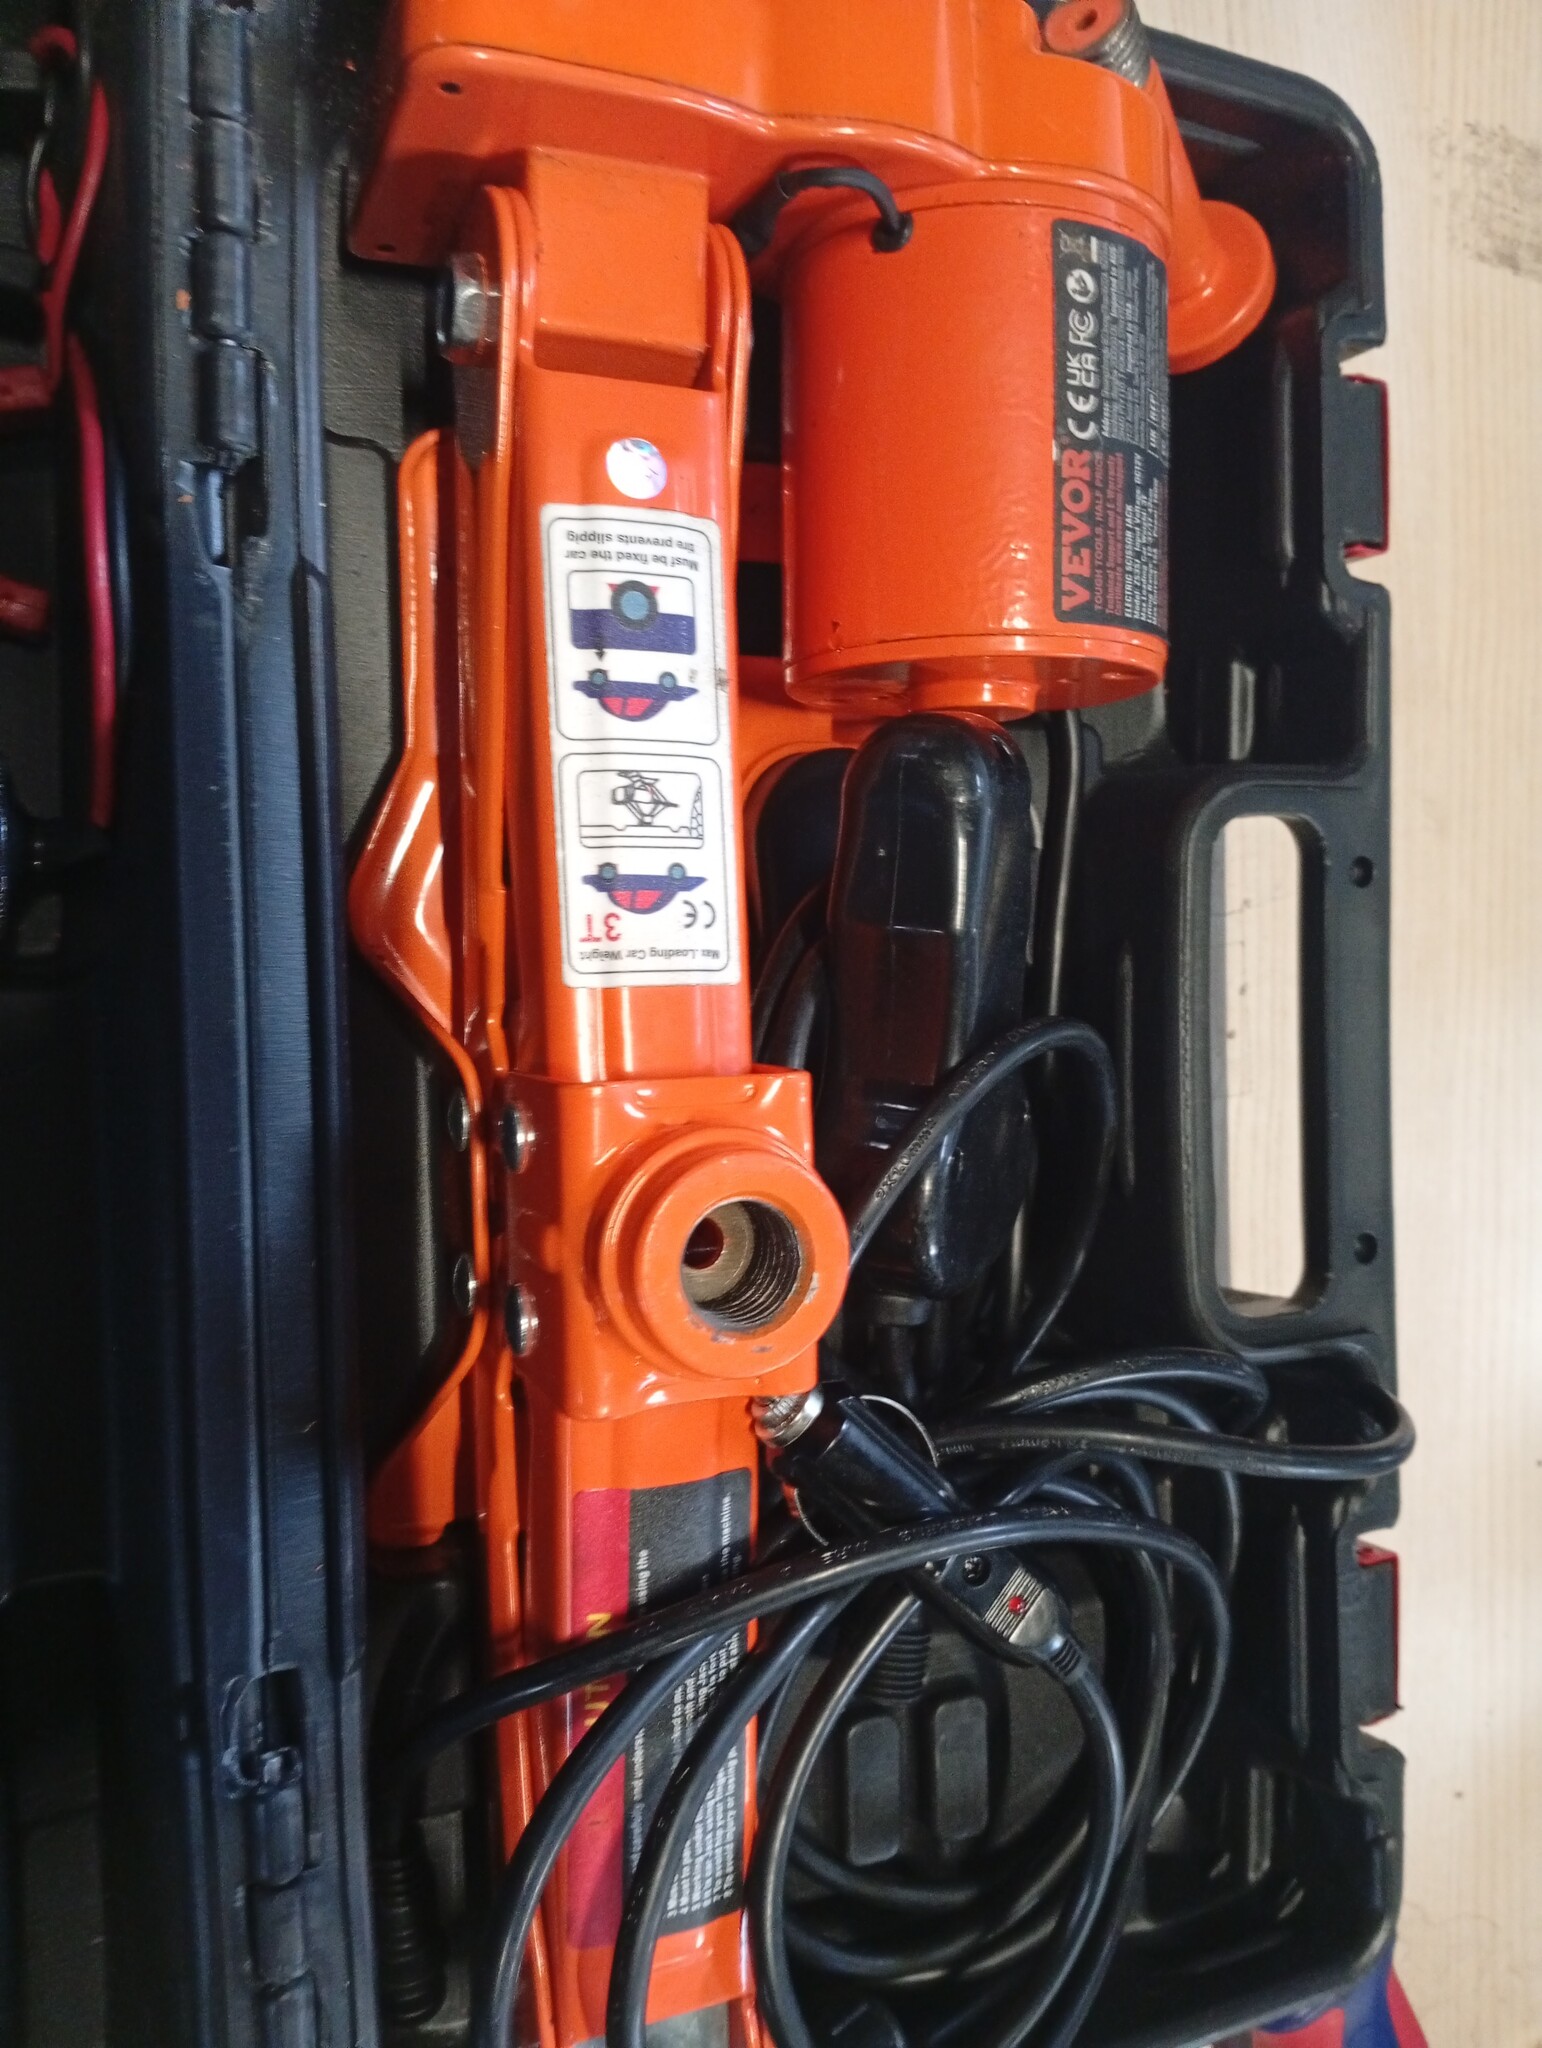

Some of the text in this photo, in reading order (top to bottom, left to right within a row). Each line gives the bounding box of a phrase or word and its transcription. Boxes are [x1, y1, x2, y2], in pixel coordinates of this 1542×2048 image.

[1095, 451, 1104, 487] PRICE
[1095, 489, 1104, 521] HALF
[1061, 448, 1091, 611] VEVOR
[1106, 511, 1114, 530] and
[566, 530, 612, 544] slippig
[617, 534, 673, 549] prevents
[564, 550, 587, 560] car
[590, 550, 612, 561] the
[616, 551, 647, 564] fixed
[1106, 531, 1116, 569] Support
[652, 554, 667, 568] be
[1125, 504, 1133, 618] ELECTRIC SCISSOR JACK
[1095, 570, 1104, 610] TOUGH
[1106, 570, 1114, 614] Technical
[578, 912, 622, 943] 3T
[578, 949, 623, 962] Weight
[626, 949, 647, 960] Car
[636, 1549, 648, 1570] the
[685, 1677, 696, 1701] and
